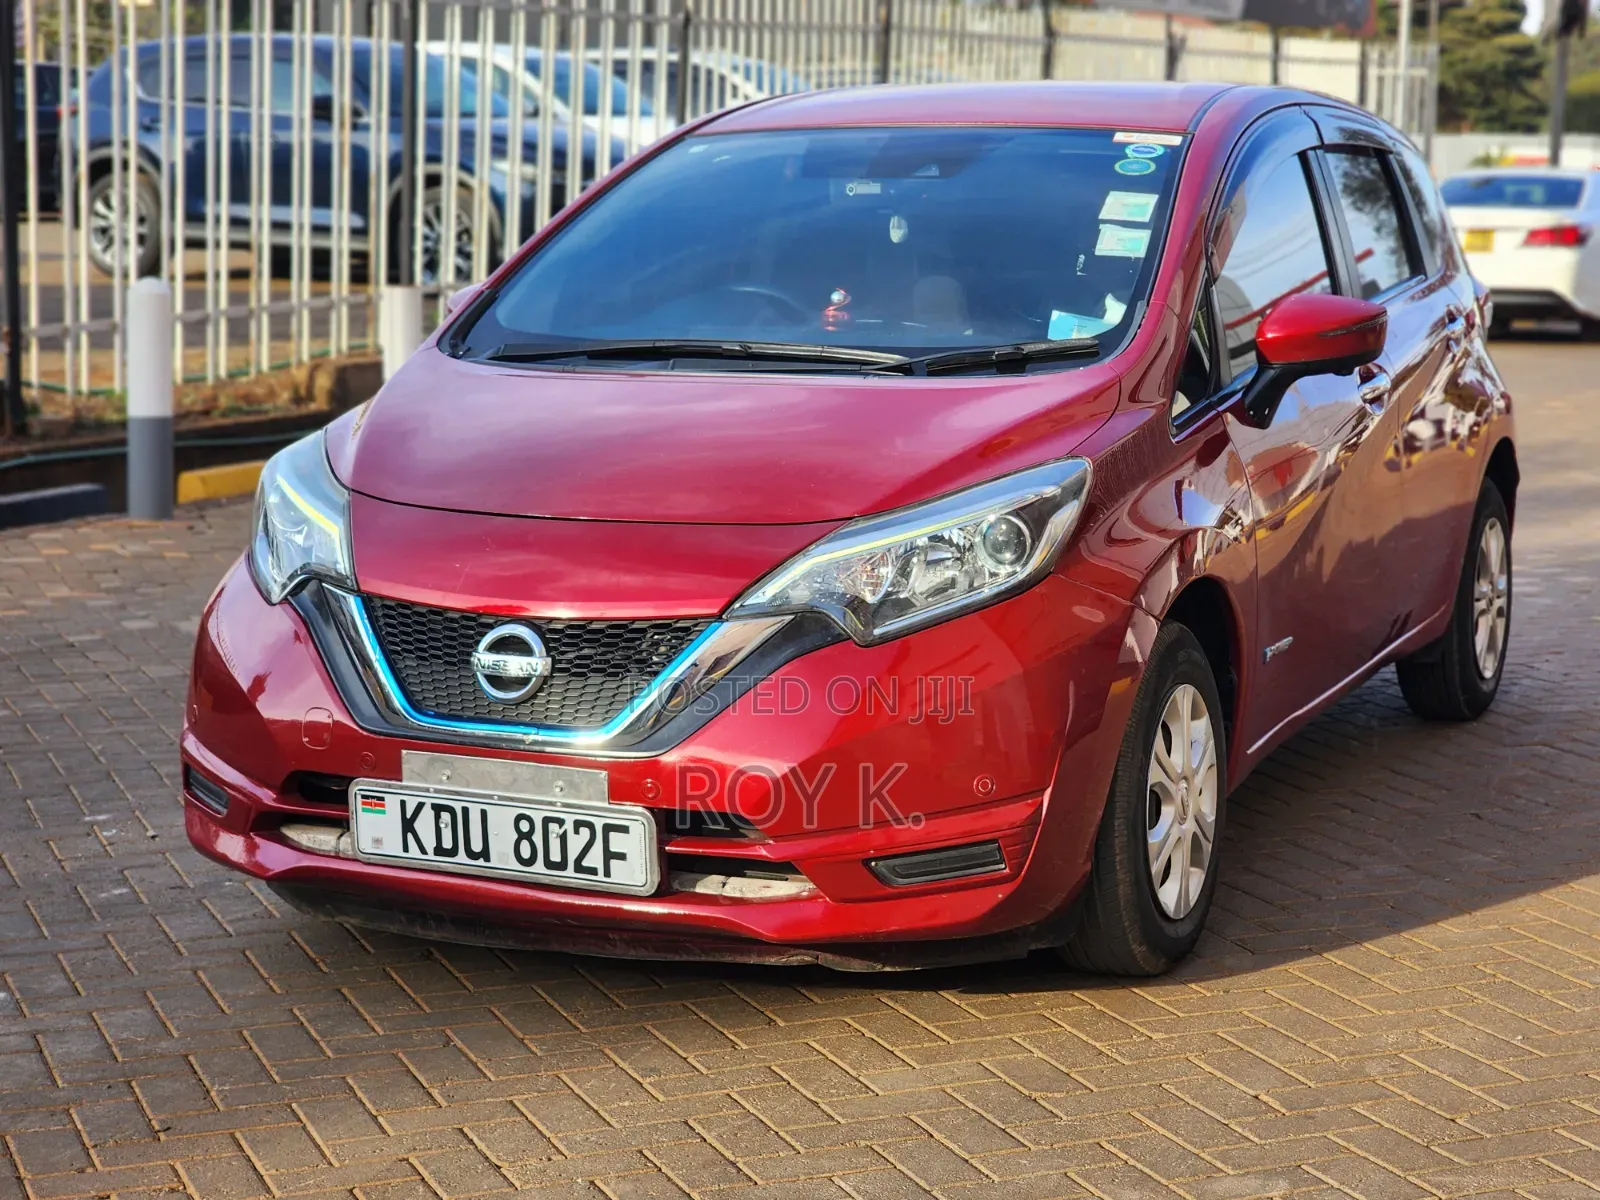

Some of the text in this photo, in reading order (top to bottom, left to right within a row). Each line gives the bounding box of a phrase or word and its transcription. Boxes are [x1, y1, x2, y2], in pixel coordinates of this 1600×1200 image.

[474, 657, 539, 674] NISSAN
[400, 799, 491, 863] KDU
[513, 812, 630, 878] 802F
